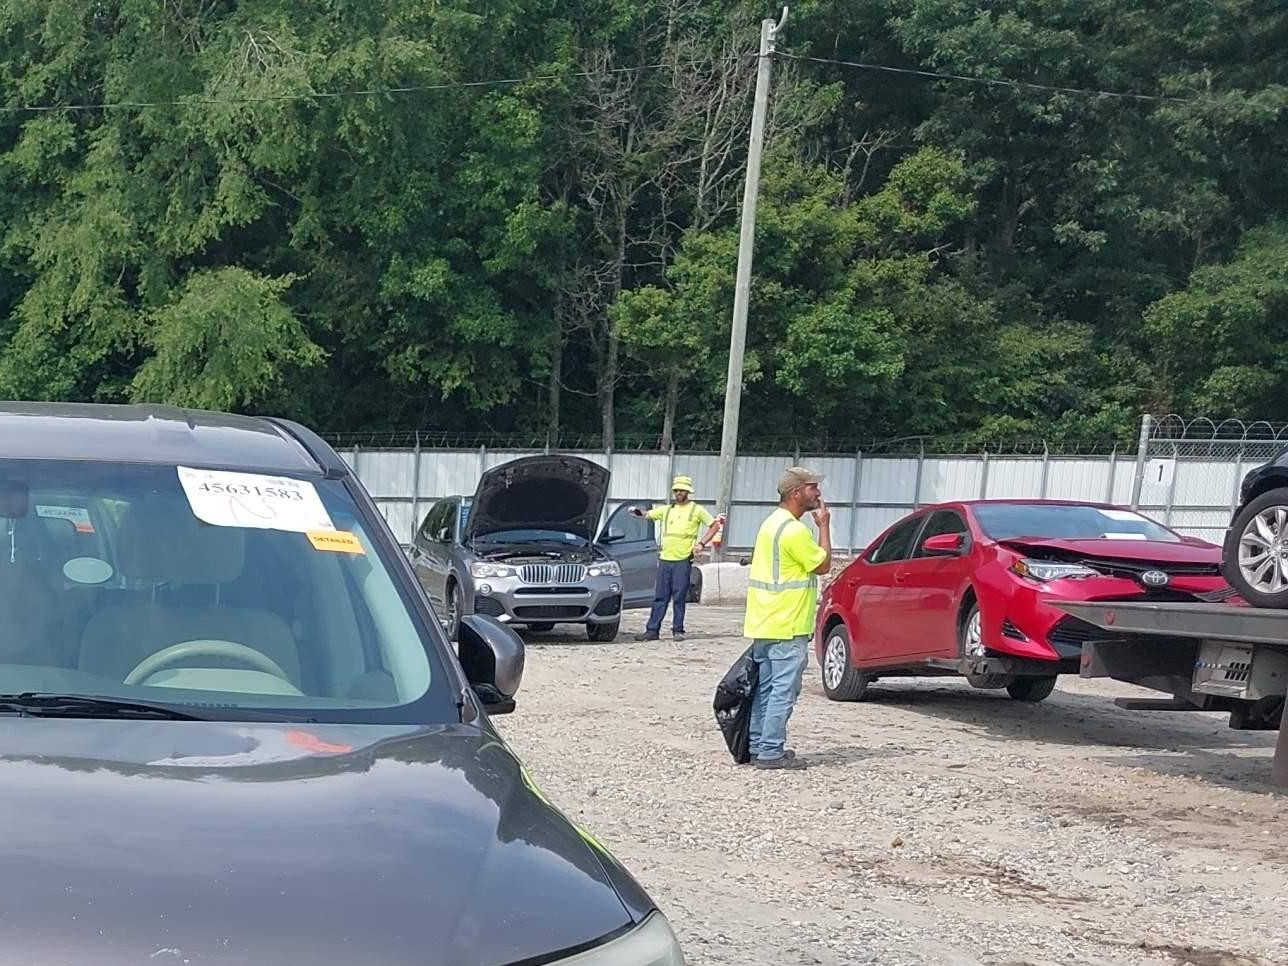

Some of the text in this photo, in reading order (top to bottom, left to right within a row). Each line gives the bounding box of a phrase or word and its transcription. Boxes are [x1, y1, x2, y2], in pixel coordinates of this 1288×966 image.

[1157, 464, 1164, 482] 1
[198, 482, 304, 502] 45631583
[313, 536, 354, 546] DETAILED
